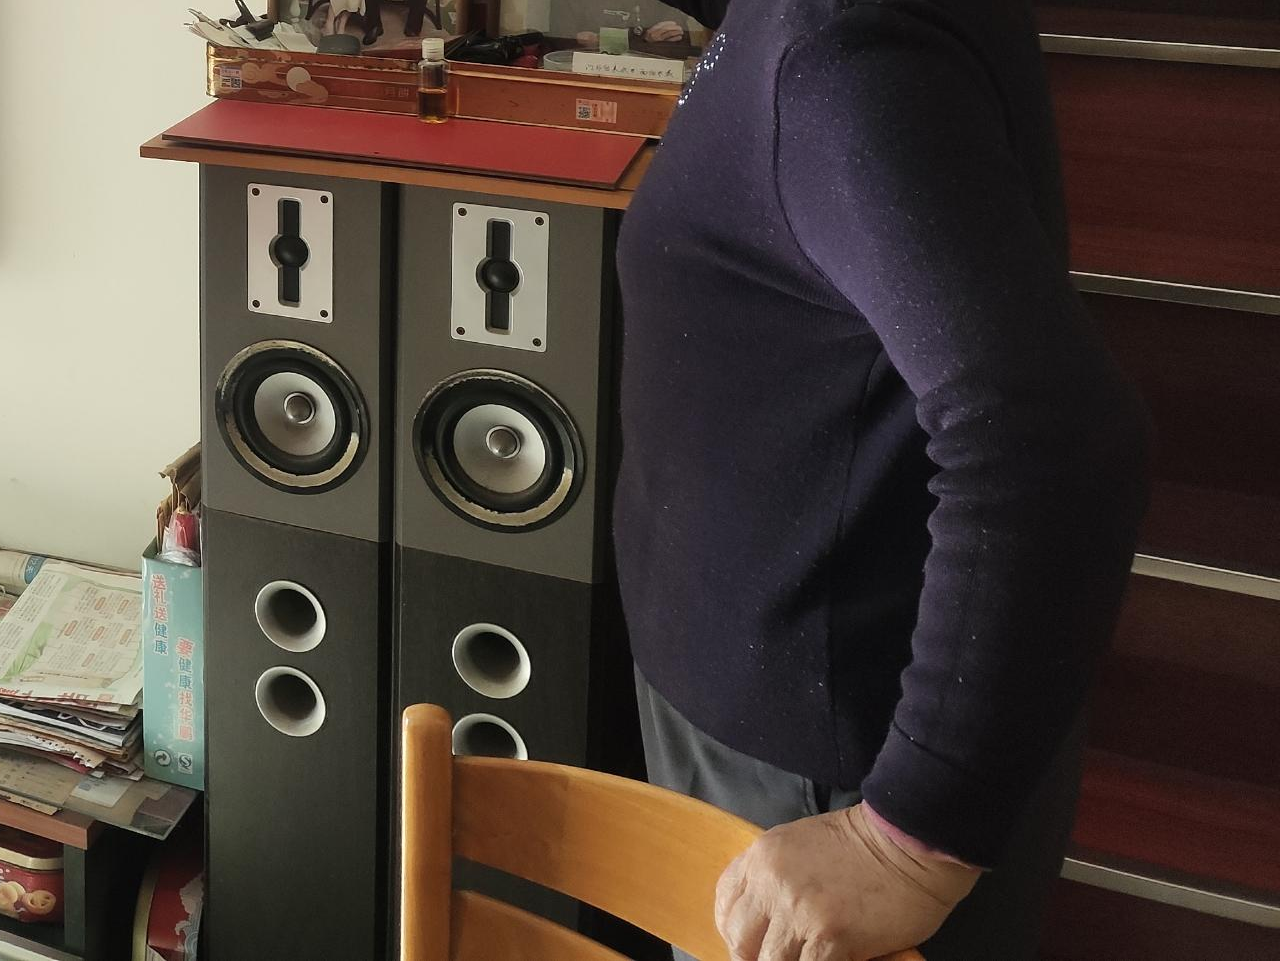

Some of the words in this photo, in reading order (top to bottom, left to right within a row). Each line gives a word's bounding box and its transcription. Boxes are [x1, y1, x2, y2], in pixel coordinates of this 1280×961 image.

[151, 574, 168, 655] 送礼送健康
